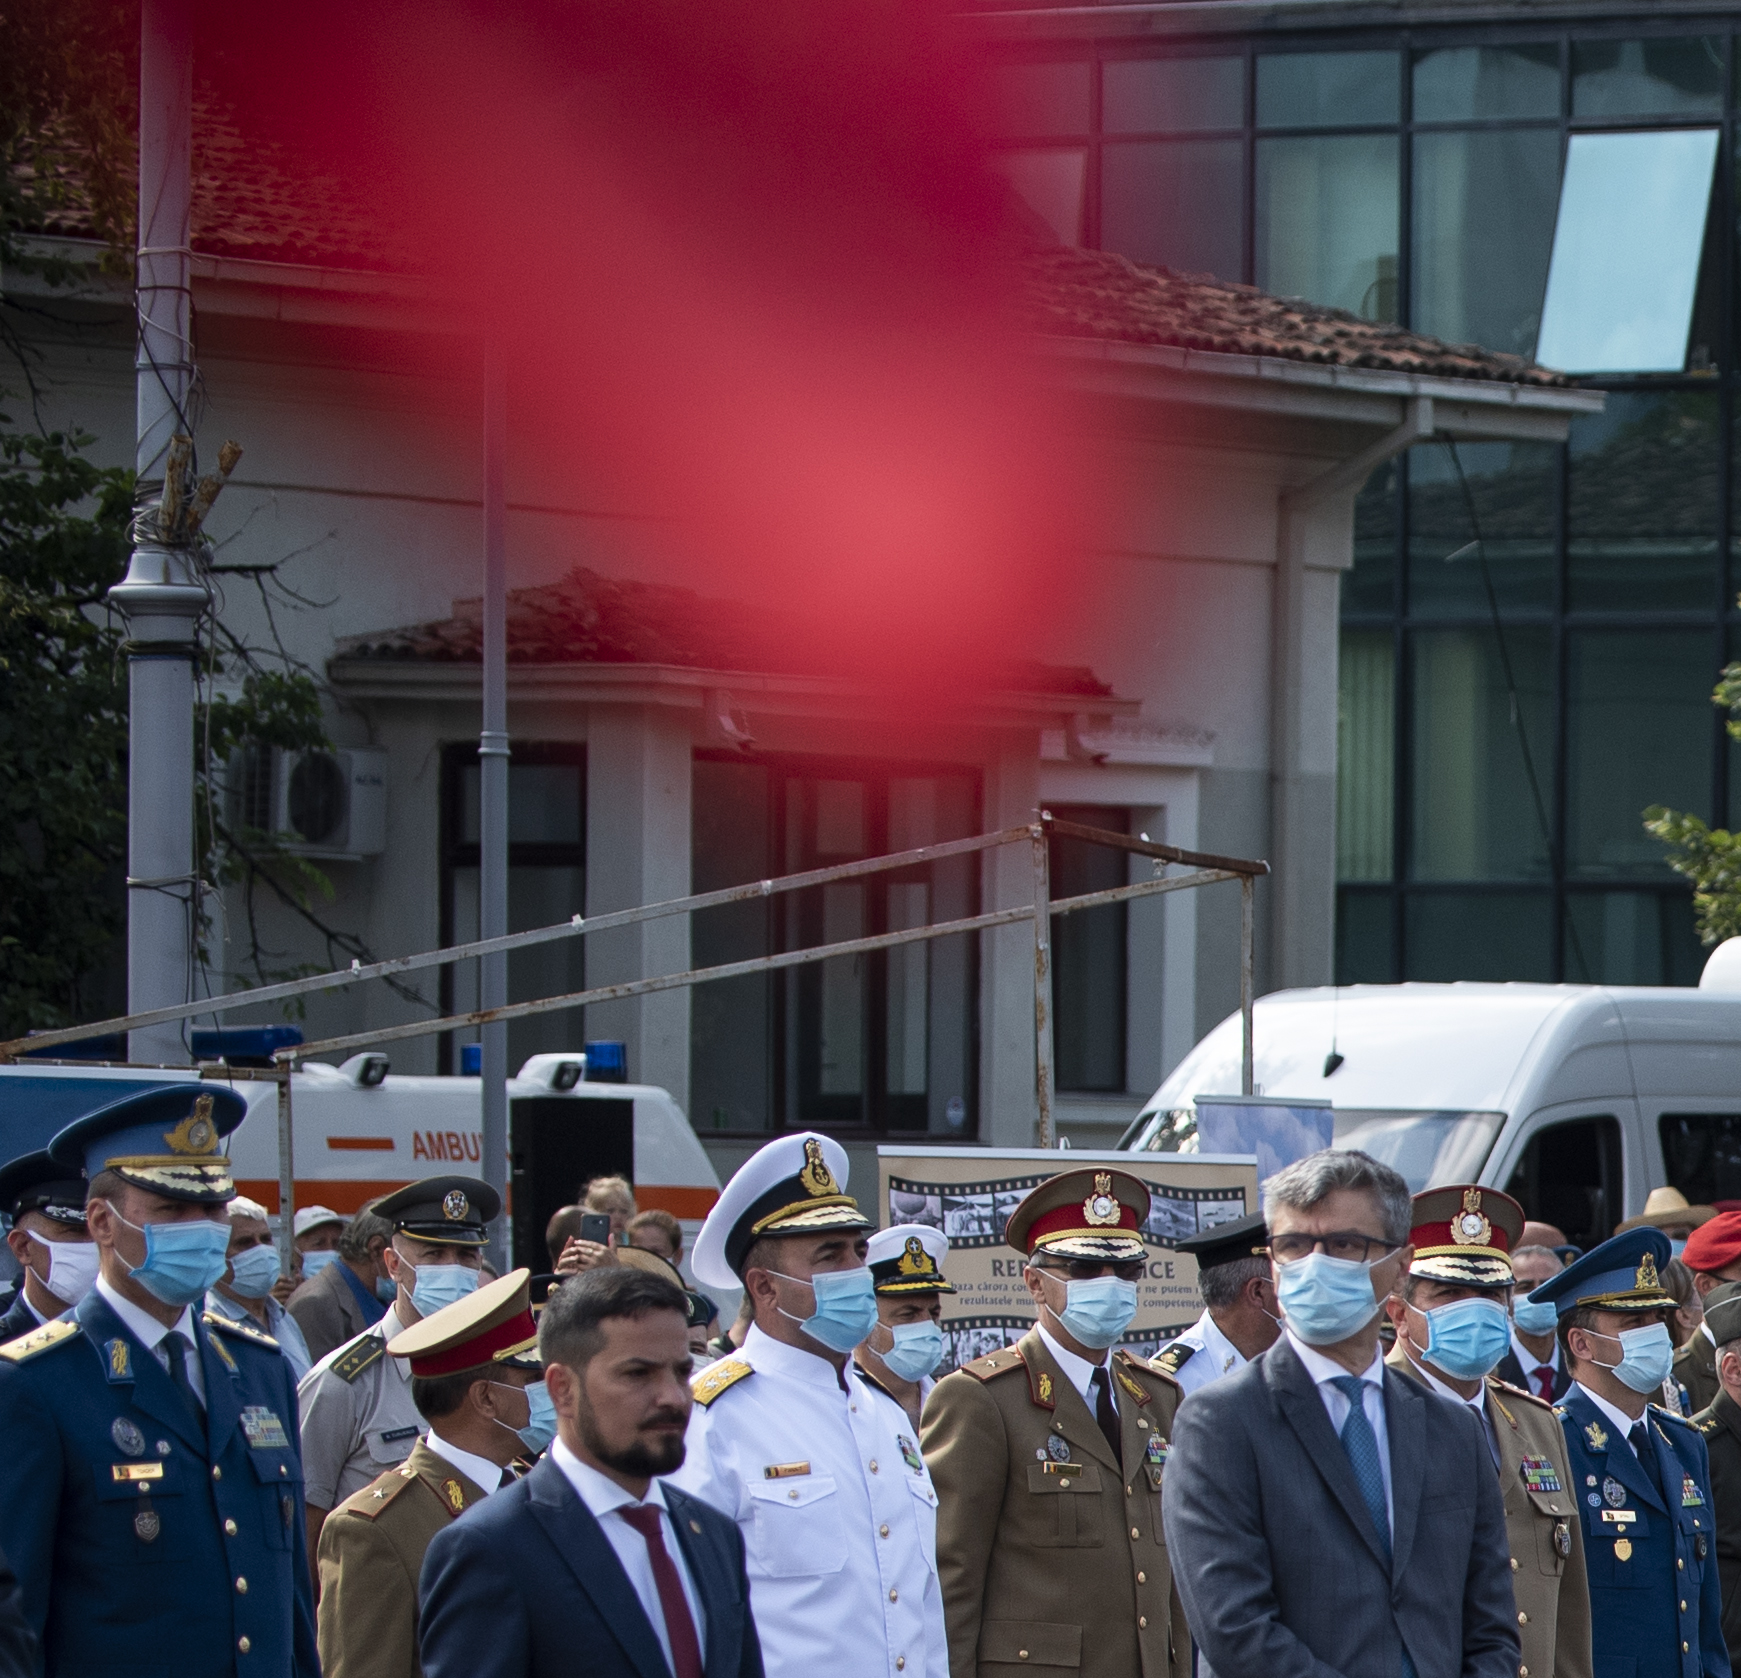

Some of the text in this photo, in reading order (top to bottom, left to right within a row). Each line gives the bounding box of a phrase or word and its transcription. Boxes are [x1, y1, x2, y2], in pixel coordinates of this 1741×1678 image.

[412, 1130, 483, 1163] AMBU
[991, 1259, 1176, 1279] REP ICE
[1145, 1286, 1157, 1294] ne
[1161, 1285, 1192, 1295] putem
[960, 1295, 1012, 1306] rezultatele
